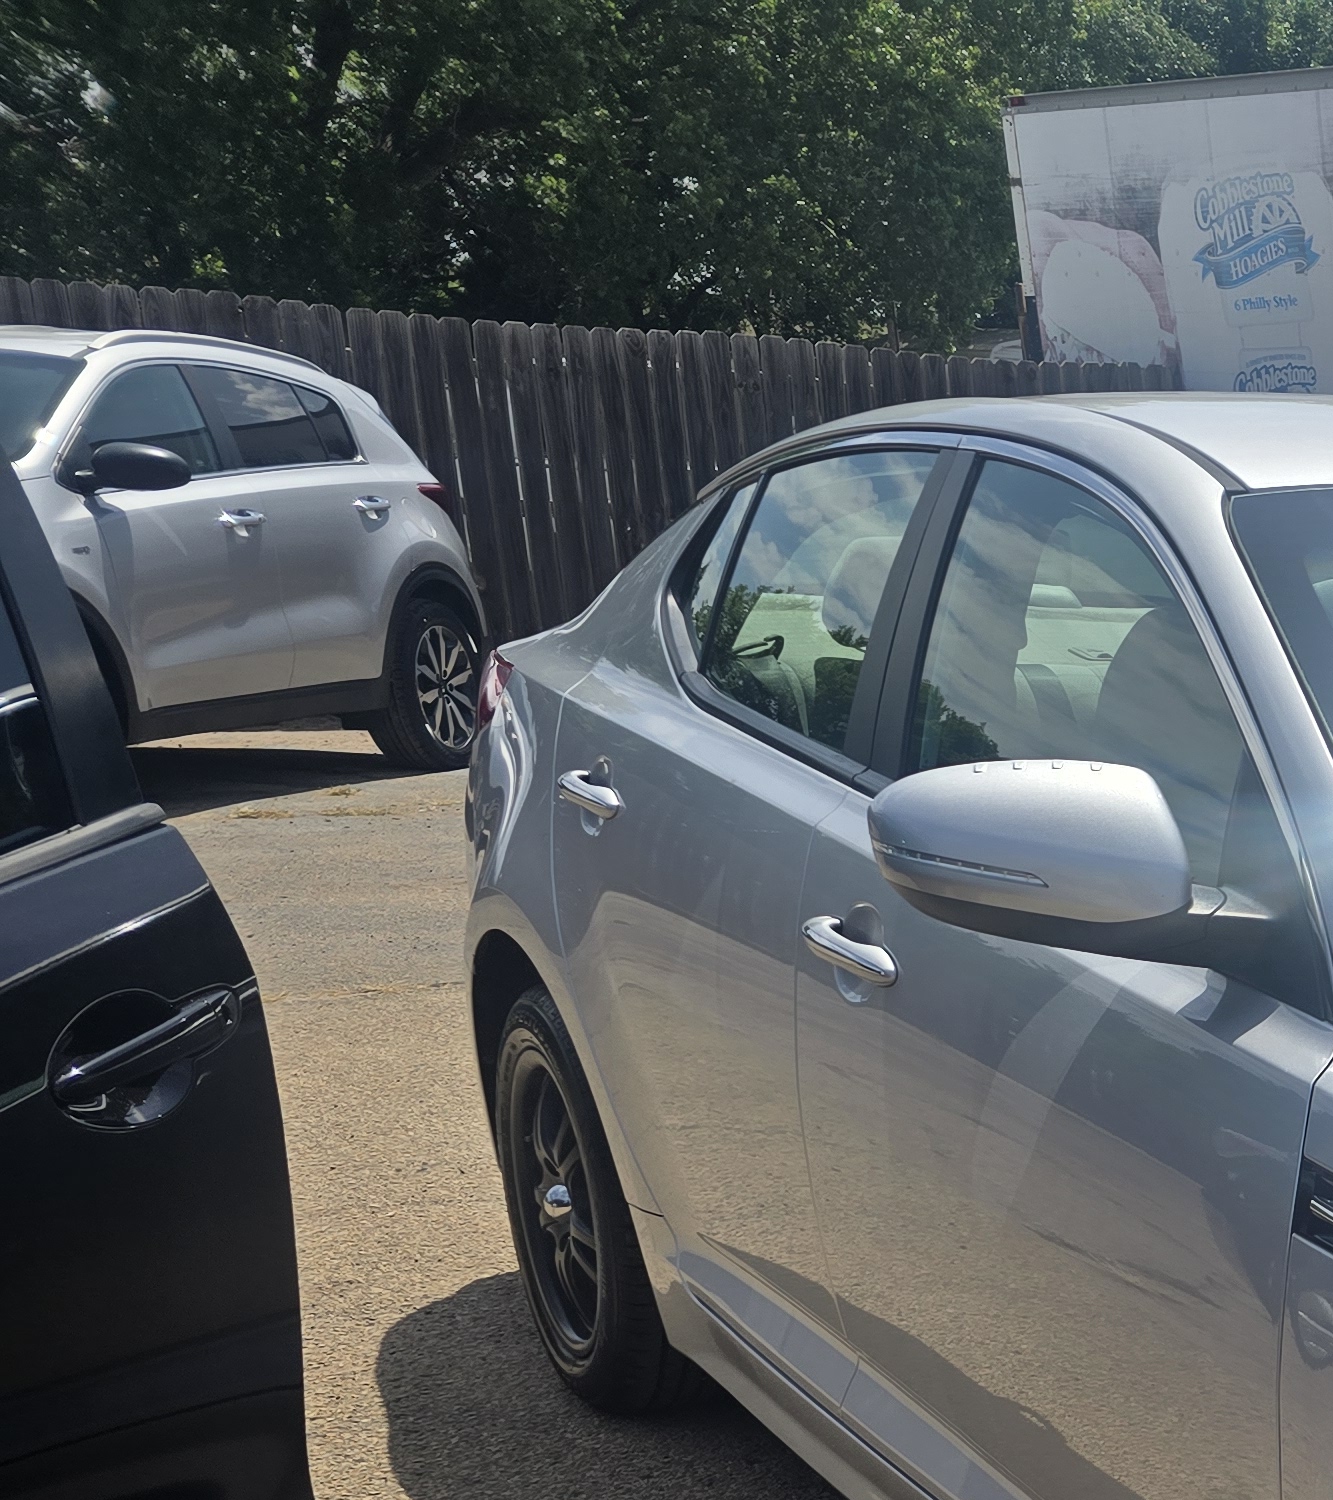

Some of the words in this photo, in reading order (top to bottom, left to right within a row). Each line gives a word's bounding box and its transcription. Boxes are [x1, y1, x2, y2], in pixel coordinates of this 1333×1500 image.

[1195, 173, 1293, 230] Cobblestone
[1212, 204, 1250, 255] Mill
[1229, 237, 1287, 281] HOAGIES
[1234, 299, 1241, 311] 6
[1241, 296, 1271, 312] Philly
[1273, 294, 1298, 311] Style
[1235, 363, 1316, 392] Cobblestone
